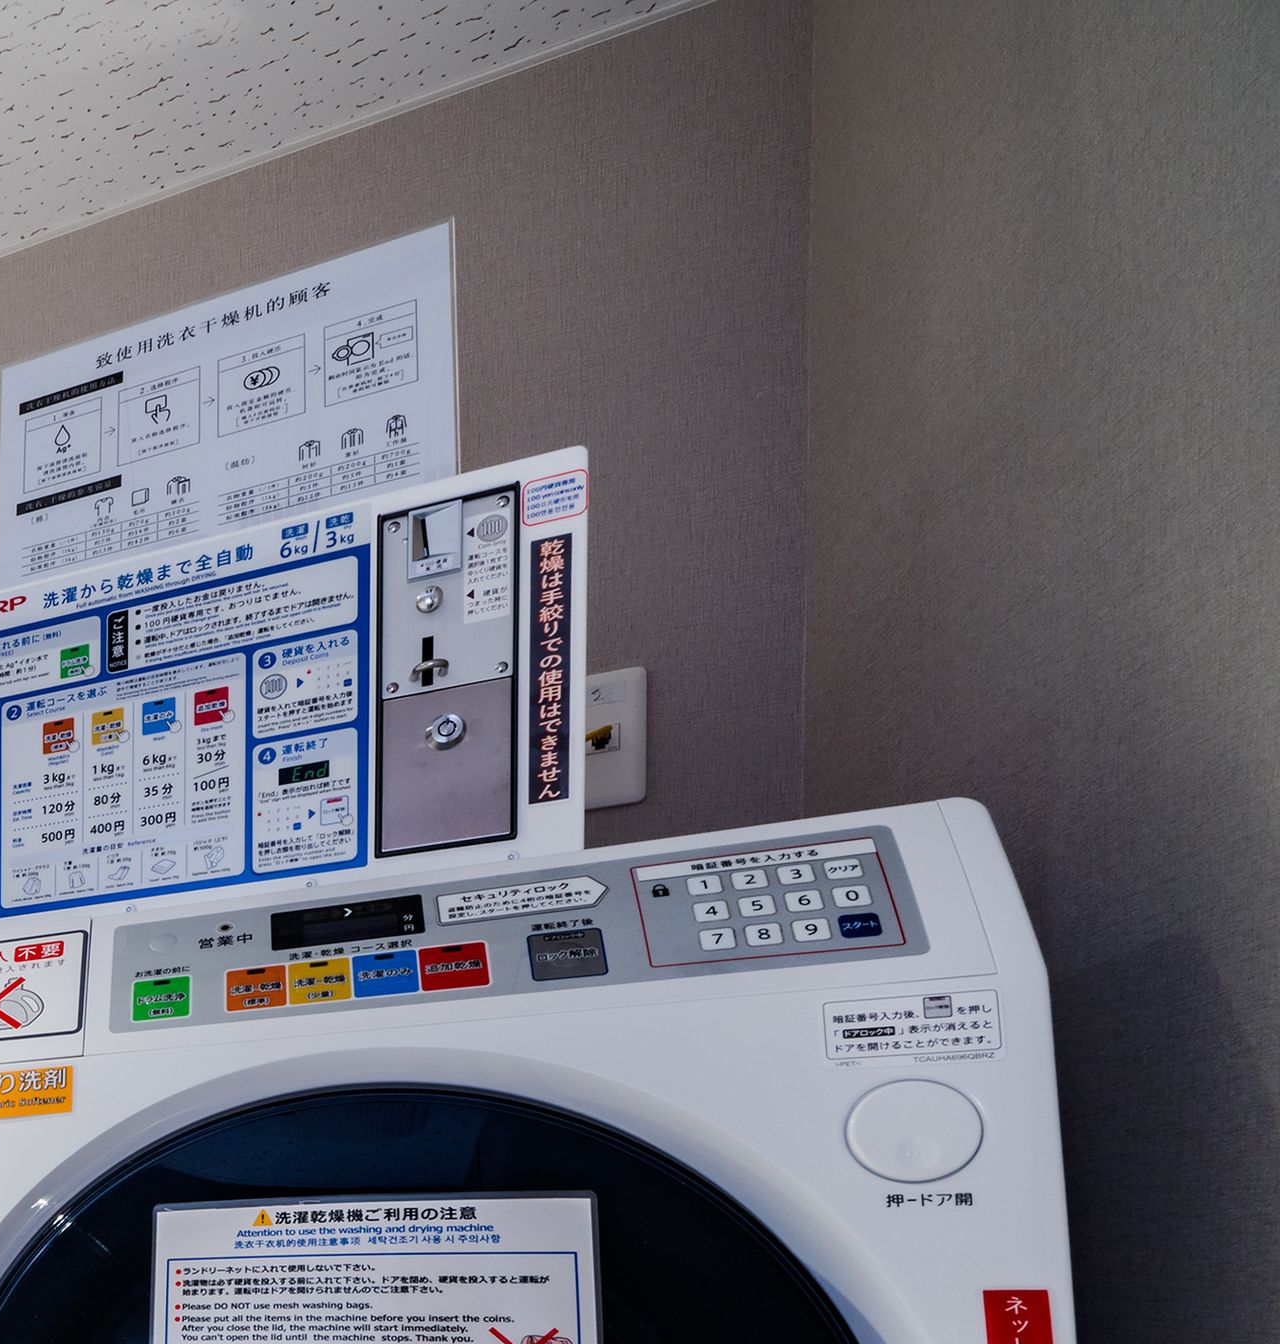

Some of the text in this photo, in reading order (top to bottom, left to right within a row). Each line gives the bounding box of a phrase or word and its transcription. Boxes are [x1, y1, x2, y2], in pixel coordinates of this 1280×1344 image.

[95, 281, 331, 370] 致使用洗衣干燥机的顾客
[43, 543, 255, 609] 洗濯から乾燥まで全自動
[111, 615, 125, 659] ご注意
[281, 637, 350, 659] 硬貨を入れる
[538, 537, 565, 801] 乾燥は手絞りでの使用はできません
[26, 686, 107, 712] 運転コースを選ぶ
[281, 738, 328, 755] 運転終了
[197, 749, 226, 764] 30分
[291, 762, 328, 782] End
[144, 783, 173, 798] 35分
[193, 776, 230, 793] 100円
[42, 800, 75, 815] 120分
[93, 792, 121, 806] 80分
[89, 820, 125, 835] 400円
[140, 811, 177, 827] 300円
[41, 828, 75, 844] 500円
[690, 848, 819, 871] 暗証番号を入力する
[701, 863, 860, 890] 1 2 3 クリア
[460, 881, 570, 903] セキュリティロック
[704, 889, 860, 917] 4 5 6 0
[531, 919, 594, 933] 運転終了後
[711, 917, 879, 945] 7 8 9 スタート
[198, 933, 253, 949] 営業中
[17, 942, 62, 961] 不要
[535, 945, 599, 962] ロック解除
[134, 965, 190, 978] お洗濯の前に
[358, 965, 414, 981] 洗濯のみ
[424, 959, 482, 976] 追加乾燥
[137, 992, 186, 1006] ドラム洗浄
[832, 1004, 992, 1025] 暗証番号入力後、 を押し
[834, 1038, 992, 1054] ドアを開けることができます。
[19, 1096, 67, 1107] Softener
[275, 1206, 478, 1225] 洗濯乾燥機ご利用の注意
[236, 1229, 283, 1238] Attention
[285, 1229, 296, 1237] to
[319, 1227, 336, 1236] the
[338, 1226, 382, 1236] washing
[385, 1225, 406, 1233] and
[408, 1224, 444, 1234] drying
[446, 1223, 494, 1233] machine
[183, 1264, 377, 1275] ランドリーネットに入れて使用しないで下さい。
[181, 1303, 212, 1311] Please
[230, 1302, 251, 1310] NOT
[302, 1301, 343, 1311] washing
[345, 1301, 373, 1311] bags.
